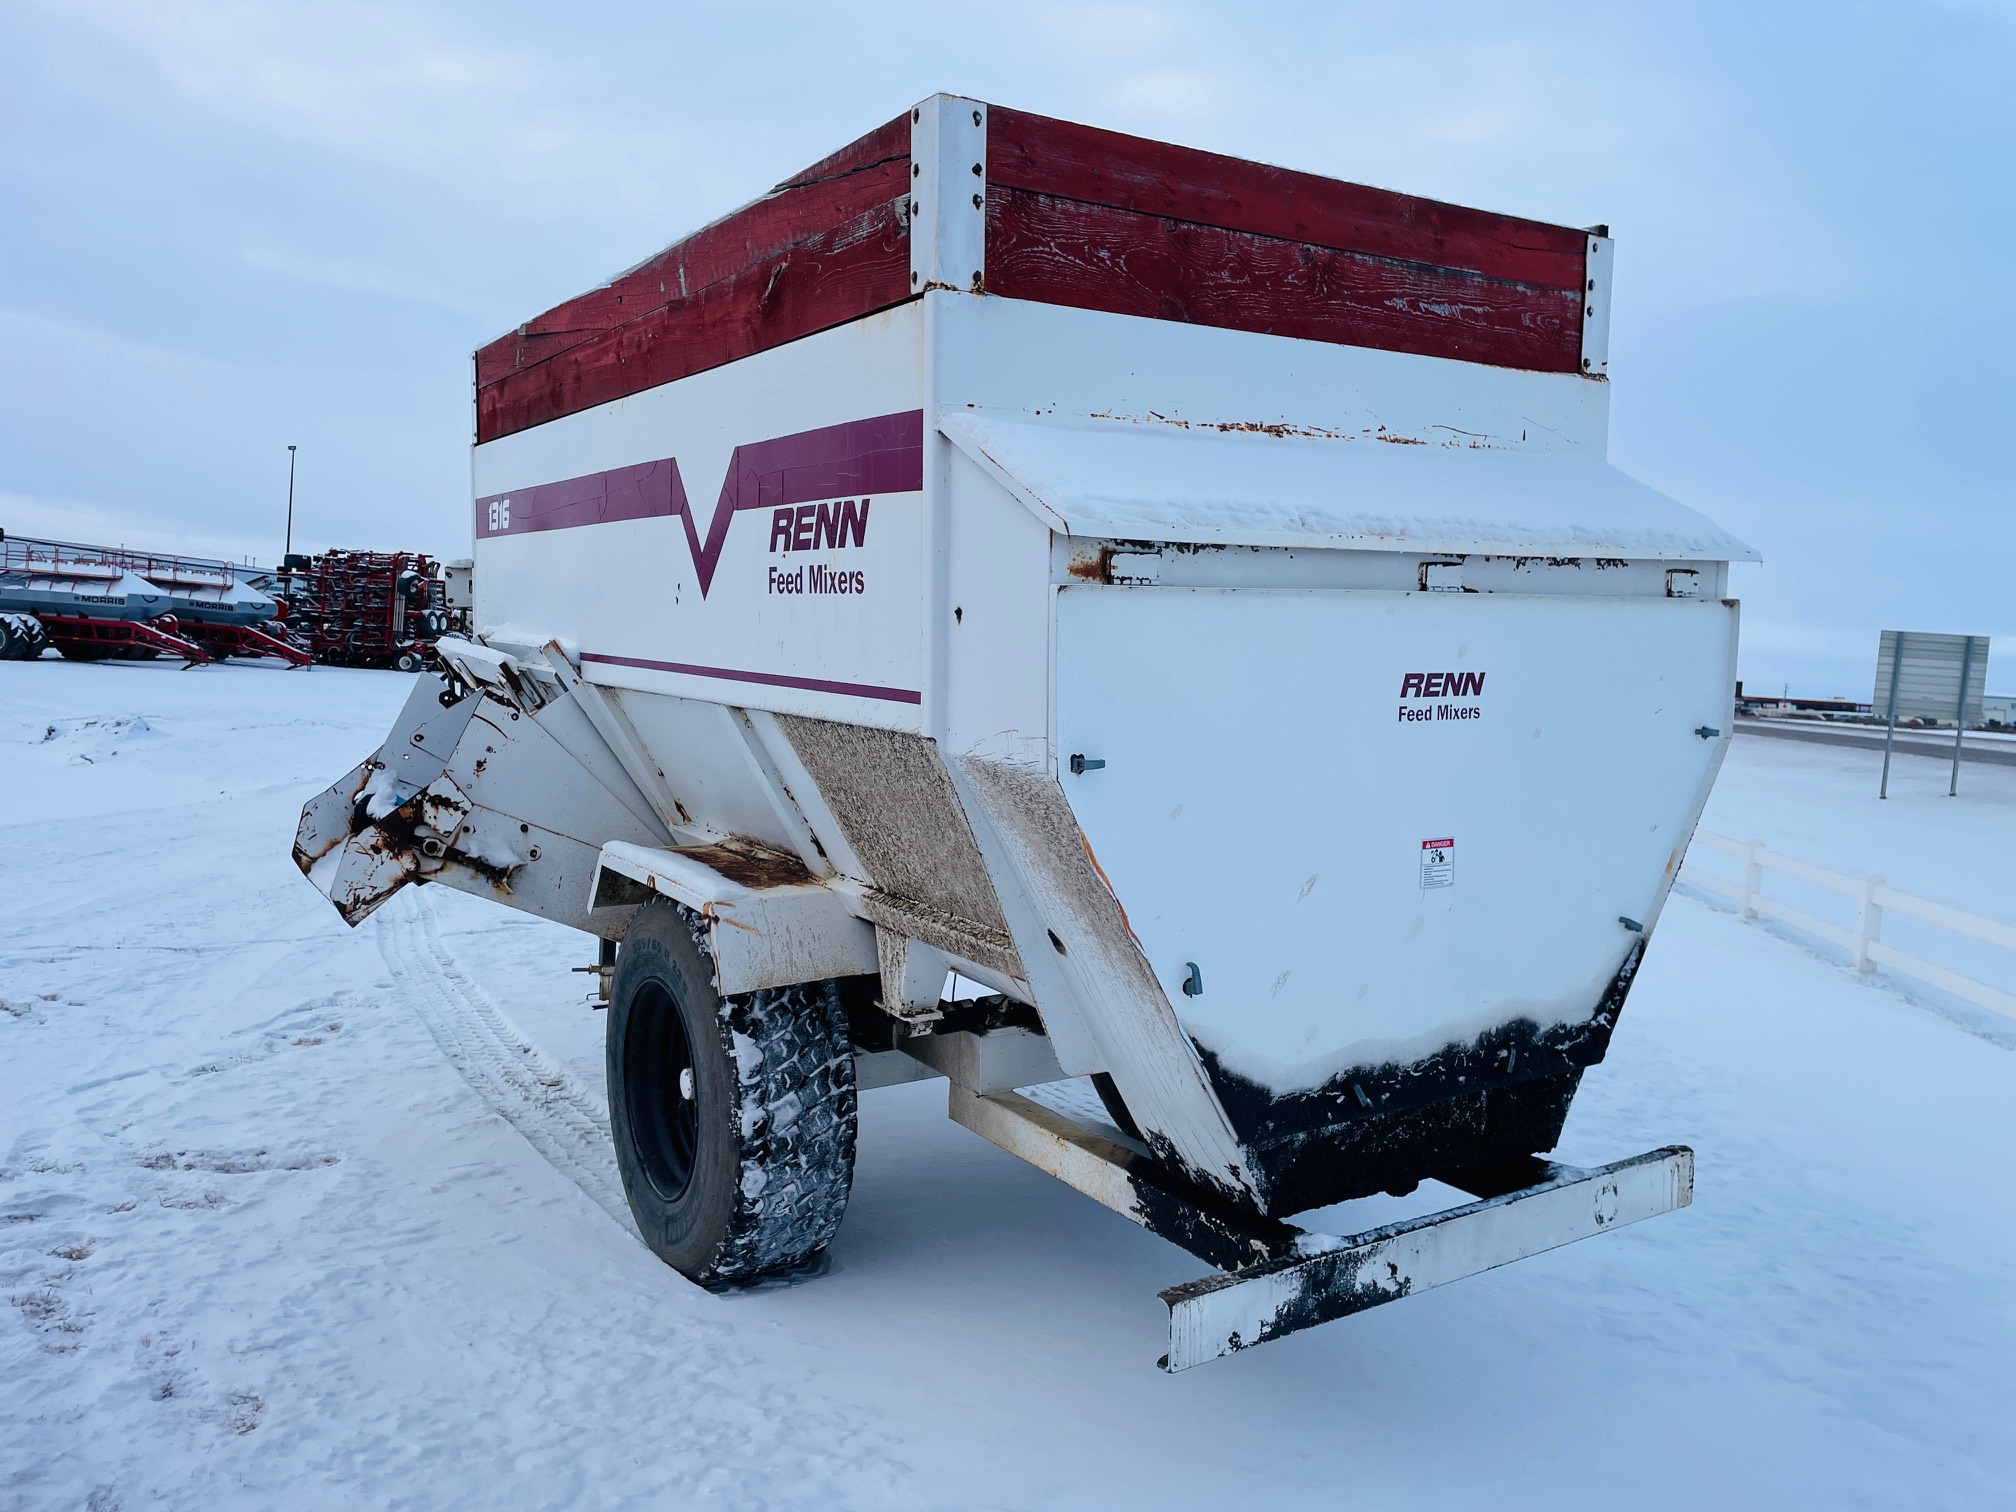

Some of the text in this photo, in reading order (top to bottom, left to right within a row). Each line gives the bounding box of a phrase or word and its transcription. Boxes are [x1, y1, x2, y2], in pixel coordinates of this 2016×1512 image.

[769, 498, 871, 553] RENN
[768, 564, 865, 595] Feed Mixers
[81, 595, 126, 606] MORRIS
[195, 601, 234, 612] MORRIS
[1400, 672, 1486, 698] RENN
[1398, 704, 1481, 722] Feed Mixers
[1430, 840, 1451, 848] DANGER
